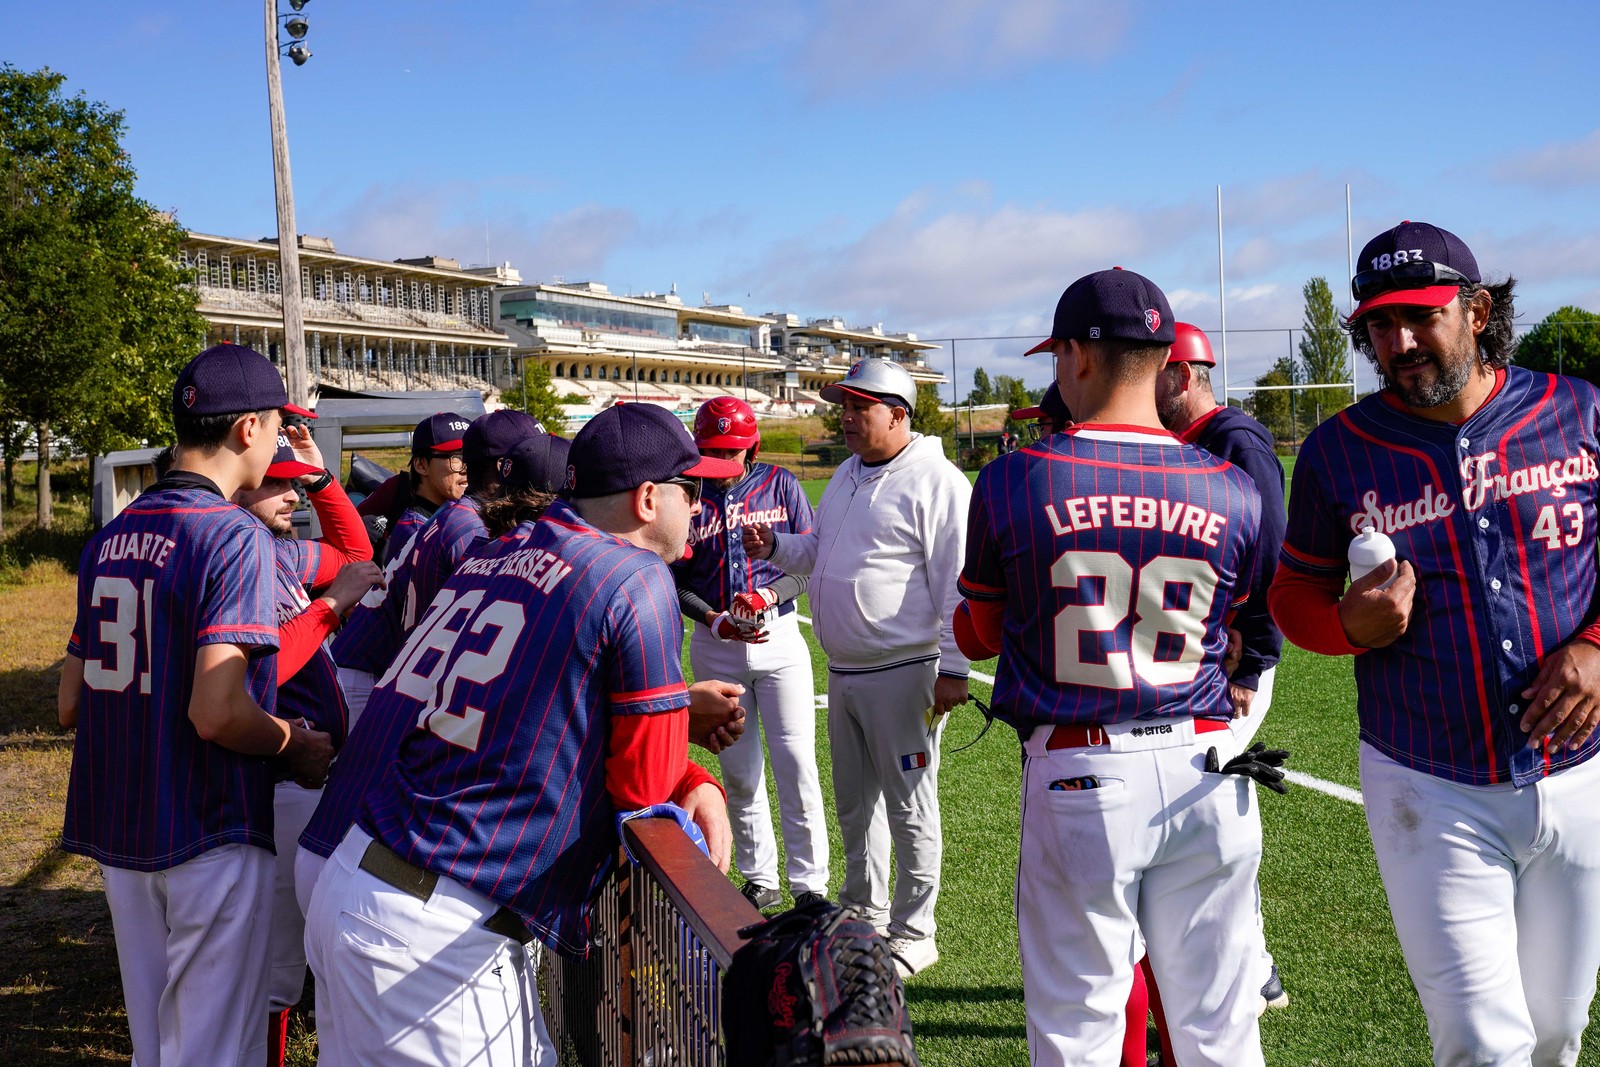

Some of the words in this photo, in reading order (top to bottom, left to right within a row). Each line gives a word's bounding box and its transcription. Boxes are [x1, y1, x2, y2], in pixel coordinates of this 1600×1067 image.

[725, 502, 788, 529] Français
[1044, 494, 1227, 547] LEFEBVRE
[1350, 484, 1456, 535] Stade
[1532, 502, 1584, 550] 43
[97, 532, 176, 568] DUARTE
[83, 575, 155, 695] 31
[1050, 550, 1220, 690] 28
